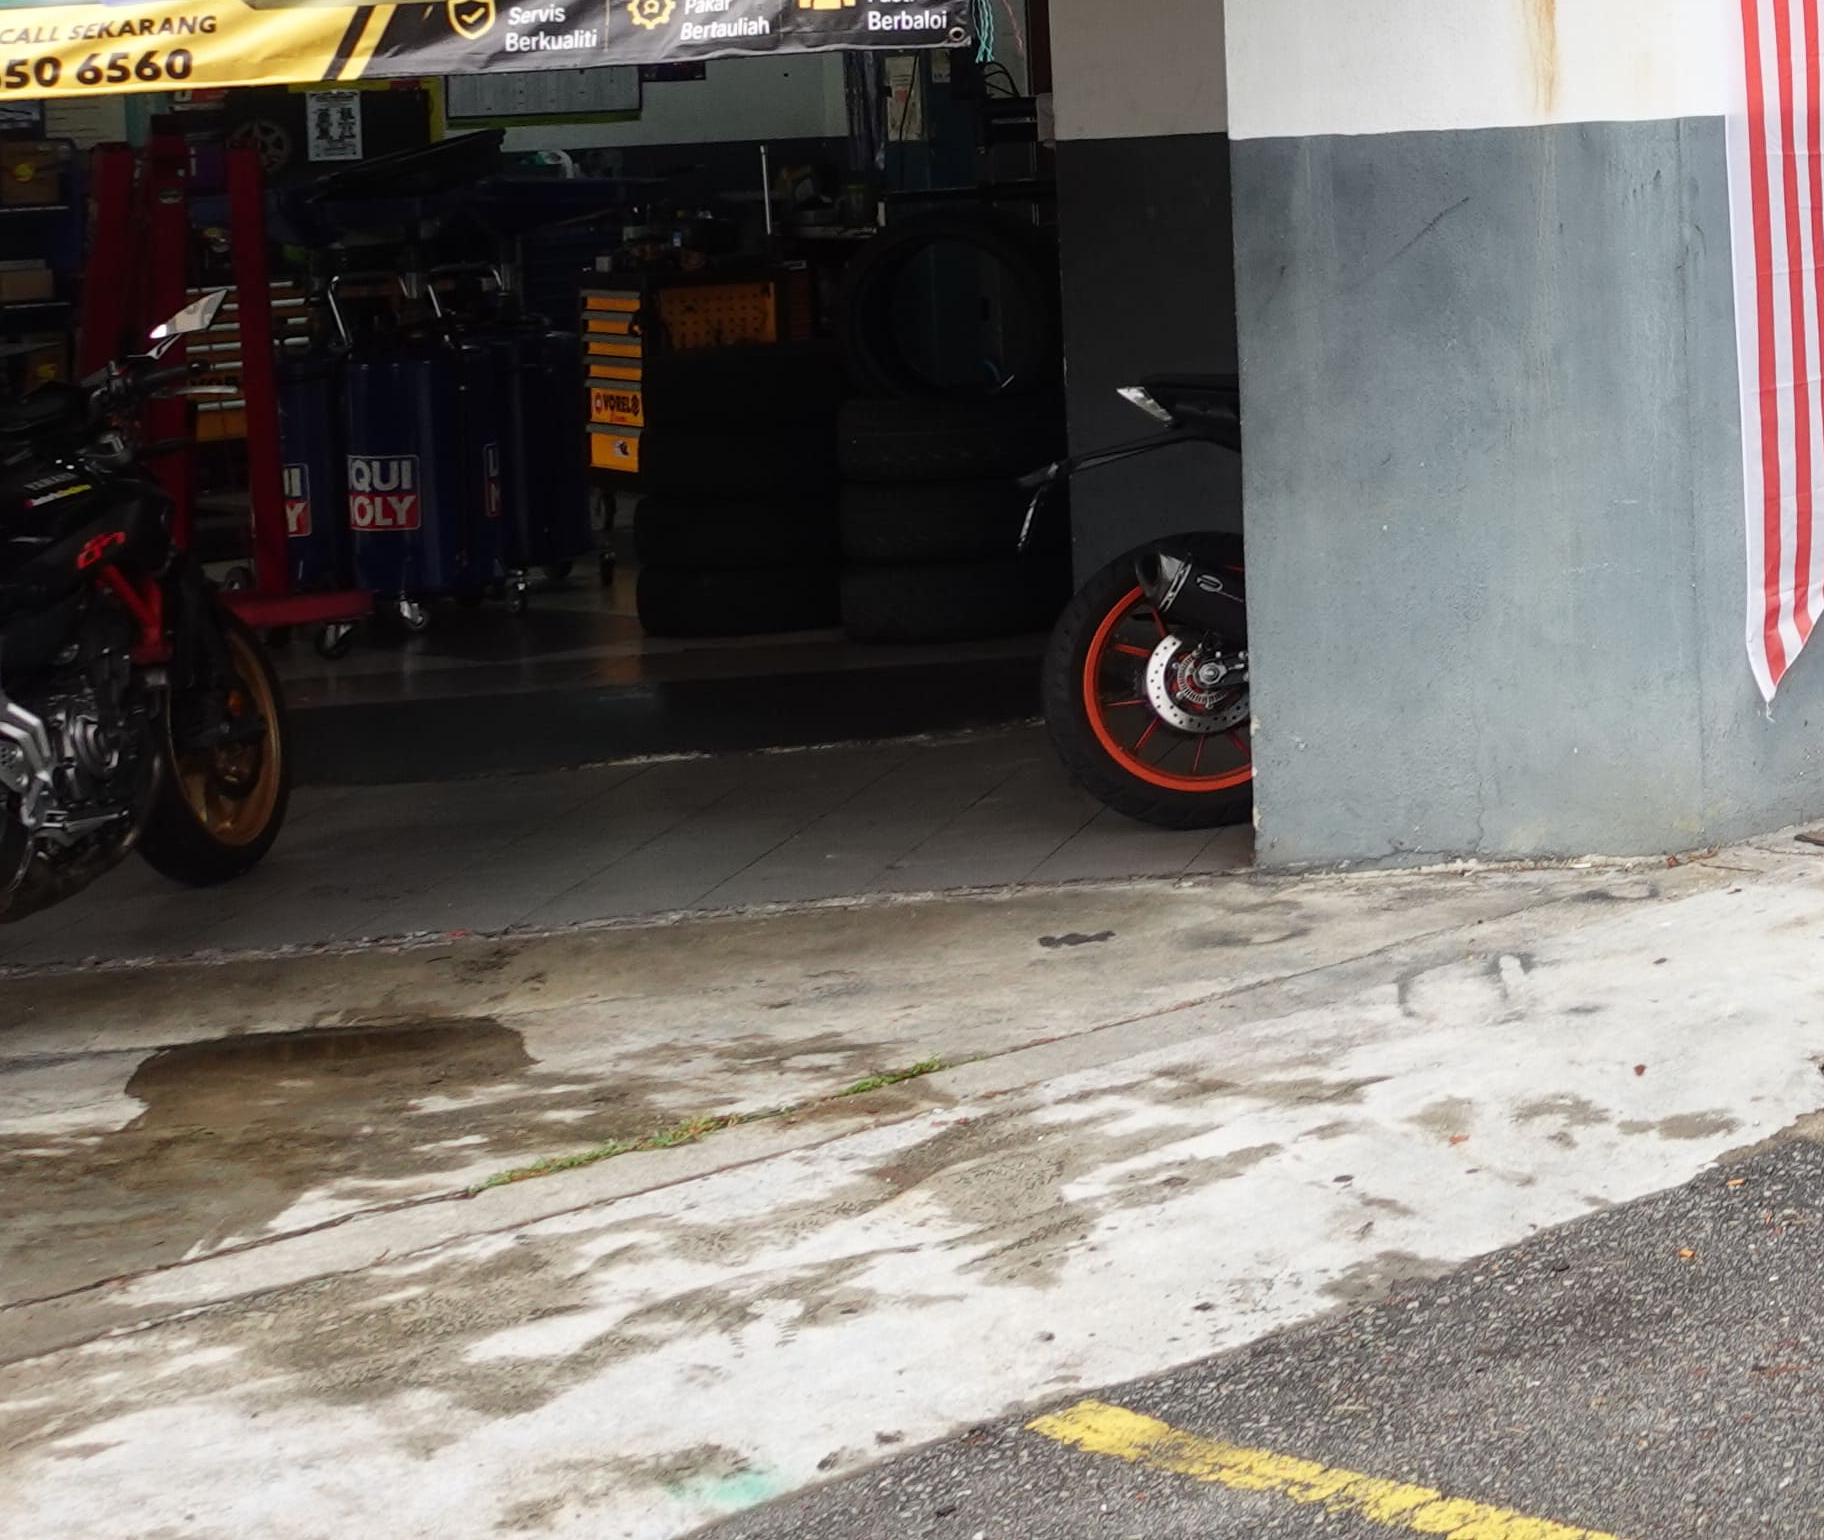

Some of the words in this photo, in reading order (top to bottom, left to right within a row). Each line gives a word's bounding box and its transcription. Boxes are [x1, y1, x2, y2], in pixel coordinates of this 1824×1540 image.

[508, 5, 566, 26] Servis
[868, 9, 947, 32] Berbaloi
[0, 26, 60, 44] CALL
[67, 15, 217, 41] SEKARANG
[505, 28, 597, 53] Berkualiti
[680, 17, 770, 42] Bertauliah
[0, 56, 62, 89] 50
[75, 48, 193, 85] 6560
[349, 495, 417, 527] OLY
